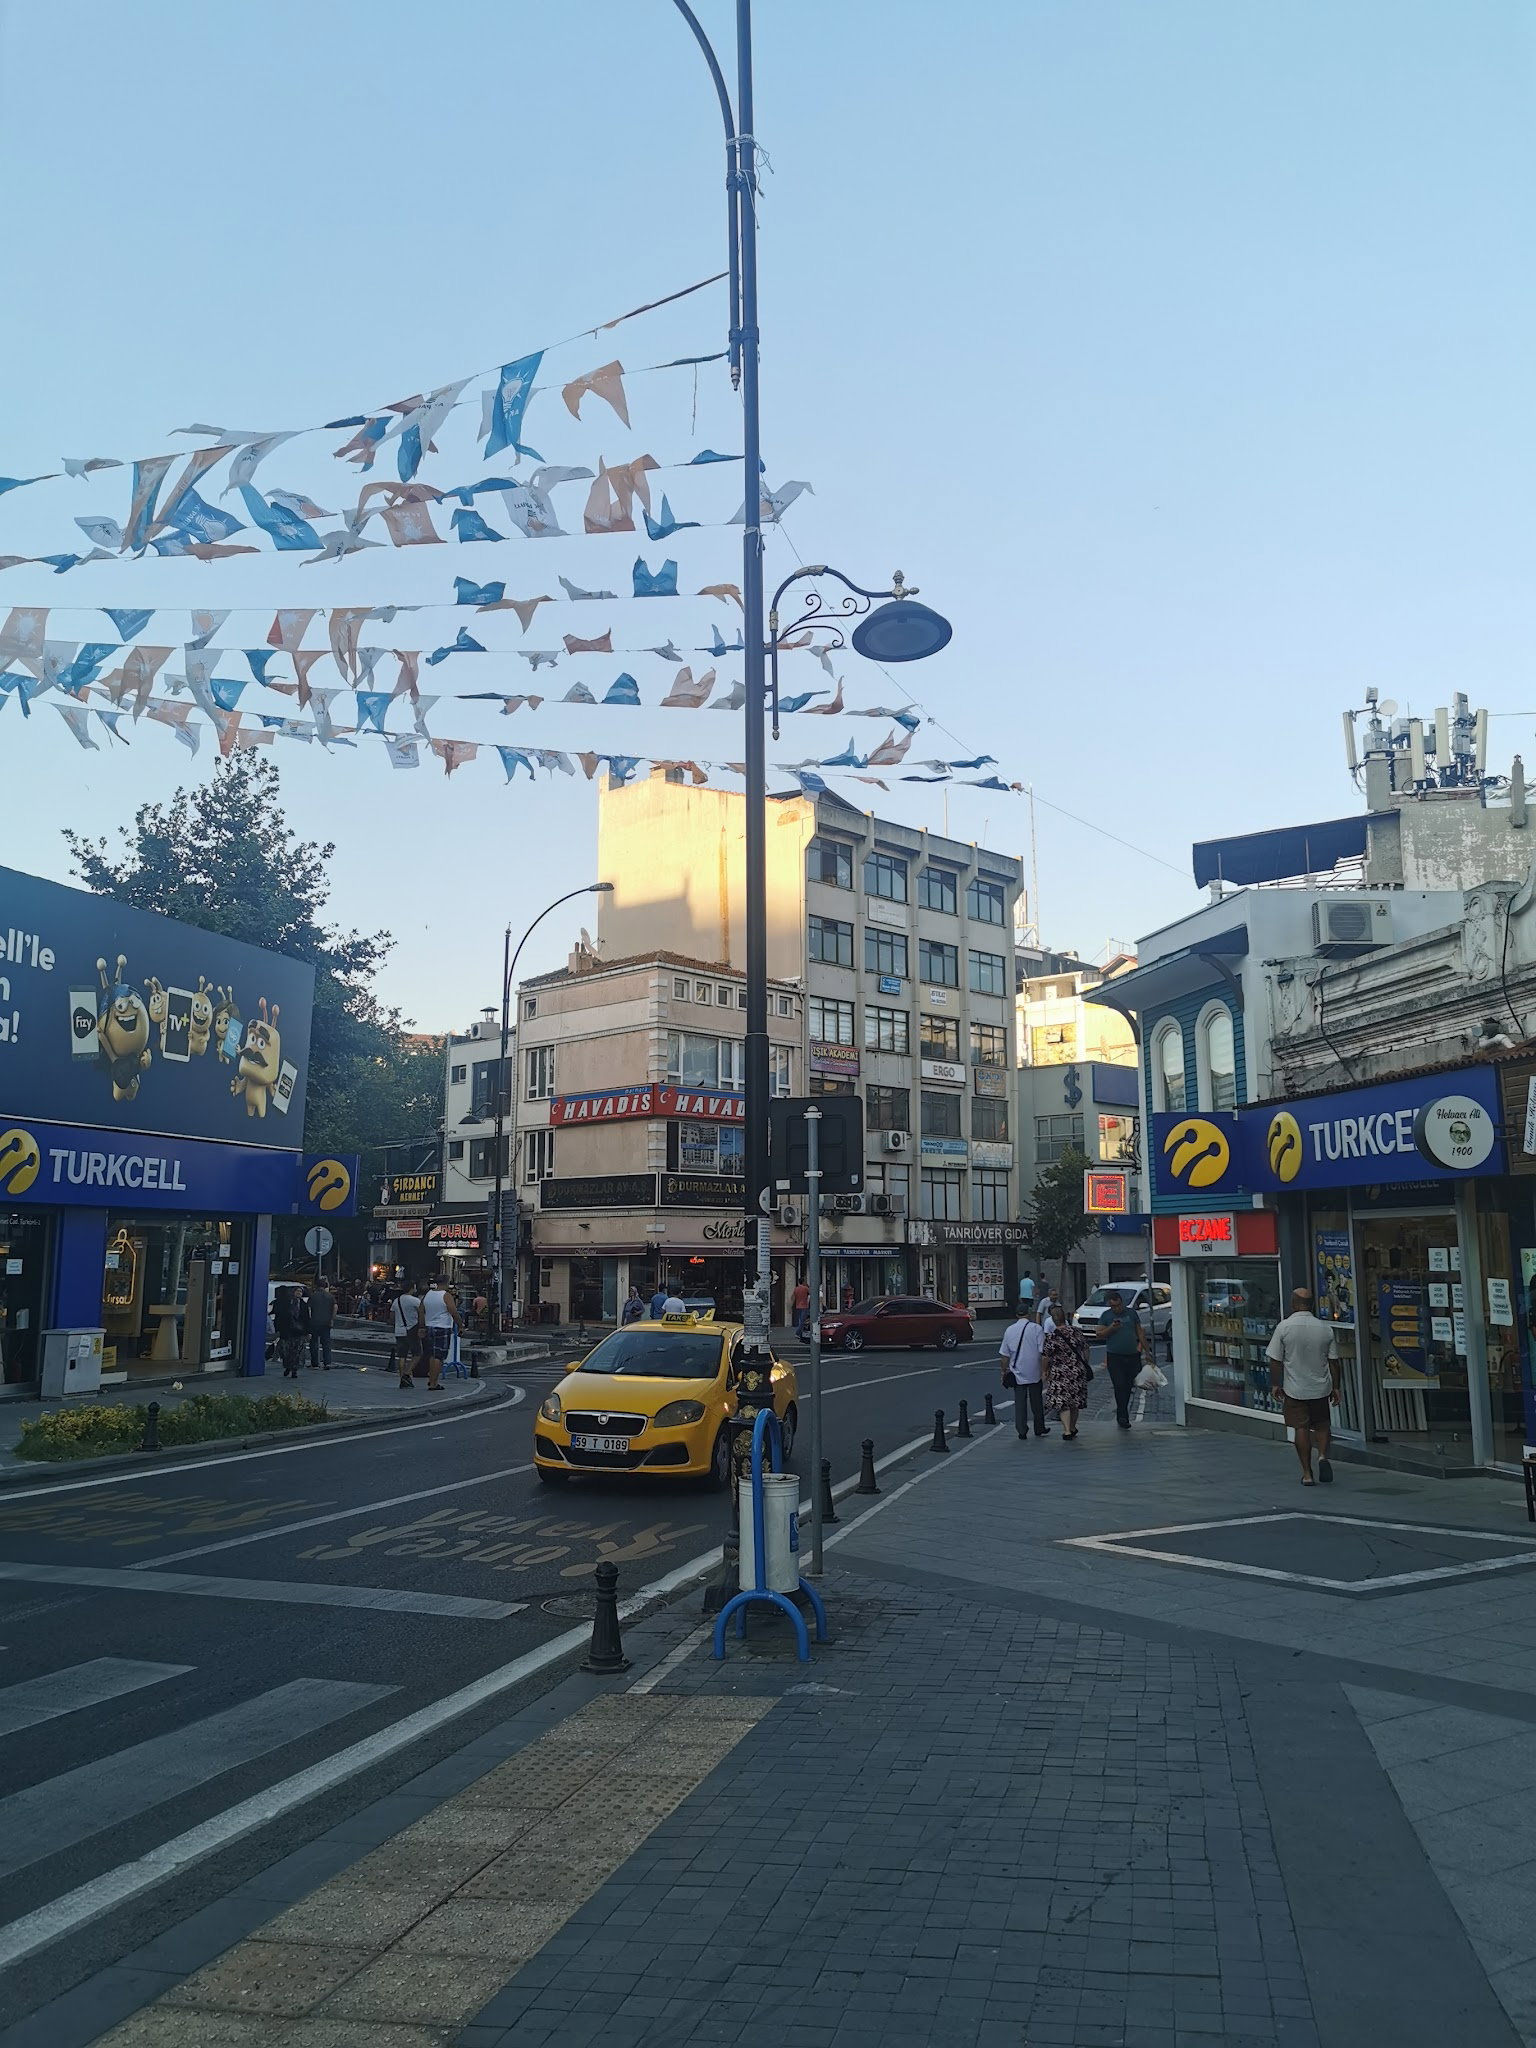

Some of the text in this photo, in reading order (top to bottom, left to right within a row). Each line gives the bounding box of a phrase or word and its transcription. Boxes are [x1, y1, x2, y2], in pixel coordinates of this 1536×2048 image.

[933, 1065, 955, 1078] ERGO
[675, 1094, 746, 1117] HAVAD
[1451, 1145, 1473, 1157] 1900
[49, 1148, 187, 1192] TURKCELL
[1005, 1228, 1029, 1240] GIDA
[1179, 1217, 1232, 1242] ECZANE
[1201, 1242, 1213, 1252] YENİ
[575, 1437, 628, 1450] 59 T 0189
